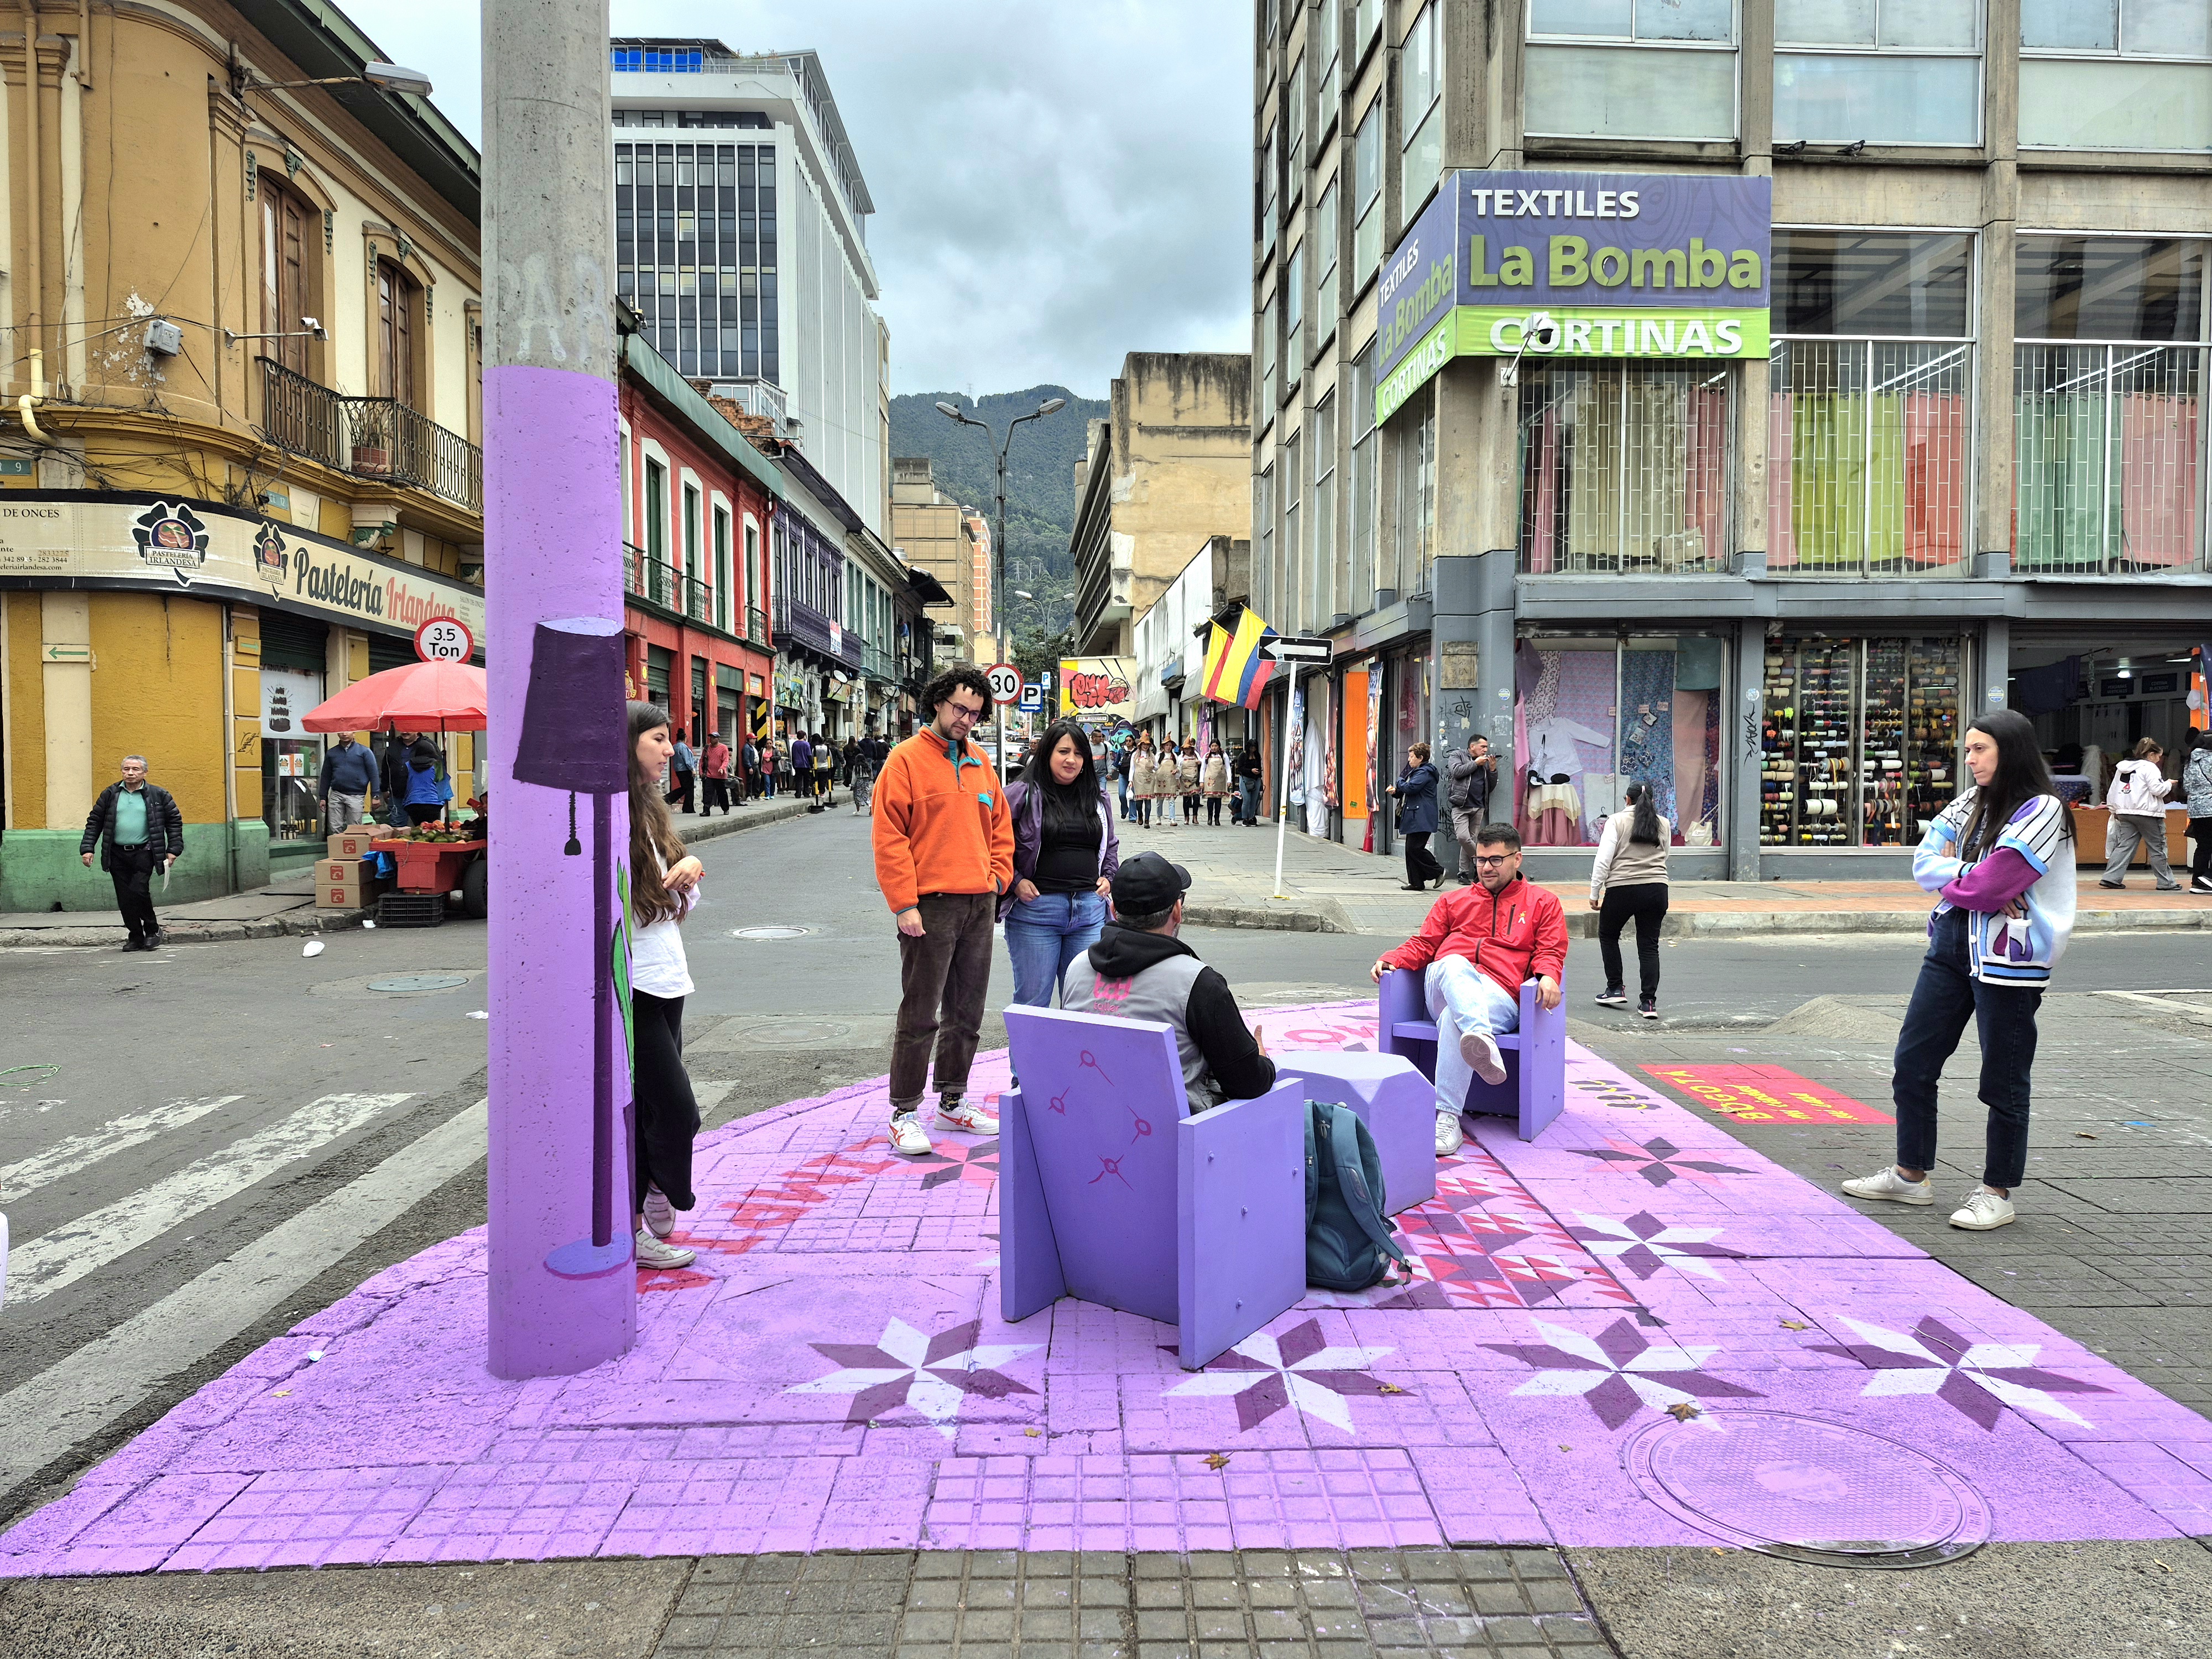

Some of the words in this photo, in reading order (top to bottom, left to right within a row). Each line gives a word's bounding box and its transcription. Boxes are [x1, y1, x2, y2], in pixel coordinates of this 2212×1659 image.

[1472, 189, 1640, 218] TEXTILES
[1470, 234, 1533, 286] La
[1548, 235, 1762, 289] Bomba
[1380, 238, 1418, 307] TEXTILES
[1378, 314, 1393, 368] La
[1395, 251, 1453, 347] Bomba
[1489, 316, 1743, 354] CORTINAS
[1382, 327, 1446, 417] CORTINAS
[3, 509, 18, 517] DE
[21, 509, 60, 518] ONCES
[150, 557, 196, 566] IRLANDESA
[152, 550, 193, 559] PASTELERÍA
[294, 547, 383, 616] Pastelería
[433, 628, 456, 641] 3.5
[429, 643, 460, 657] Ton
[991, 675, 1015, 693] 30
[1043, 674, 1048, 682] P
[1024, 687, 1037, 702] P
[1093, 1001, 1120, 1013] taller
